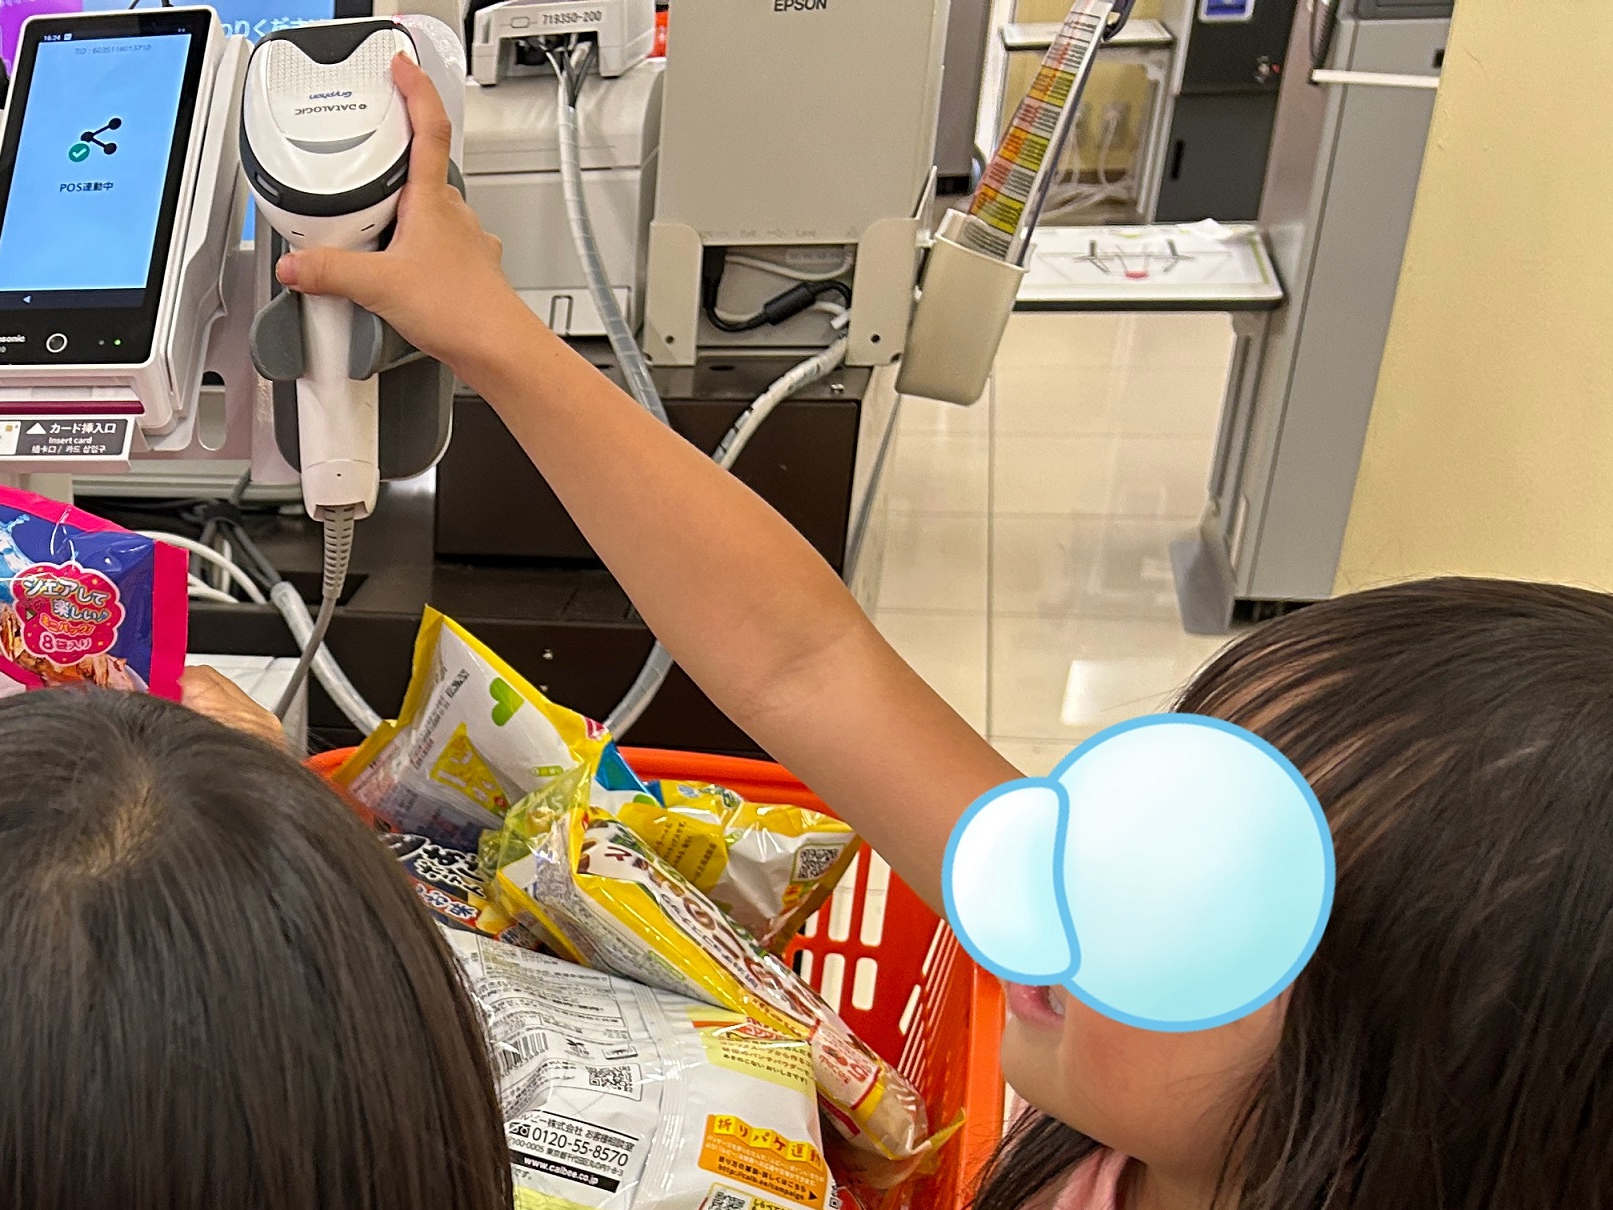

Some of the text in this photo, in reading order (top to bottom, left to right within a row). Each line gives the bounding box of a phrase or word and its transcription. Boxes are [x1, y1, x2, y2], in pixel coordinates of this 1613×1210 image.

[773, 0, 827, 12] EPSON
[309, 91, 352, 100] Gryphon
[294, 104, 357, 115] DATALOGIC
[49, 422, 116, 434] カード挿入口
[23, 578, 109, 605] シェアして
[532, 1128, 629, 1167] 0120-55-8570
[523, 1156, 599, 1185] www.calbee.co.jp
